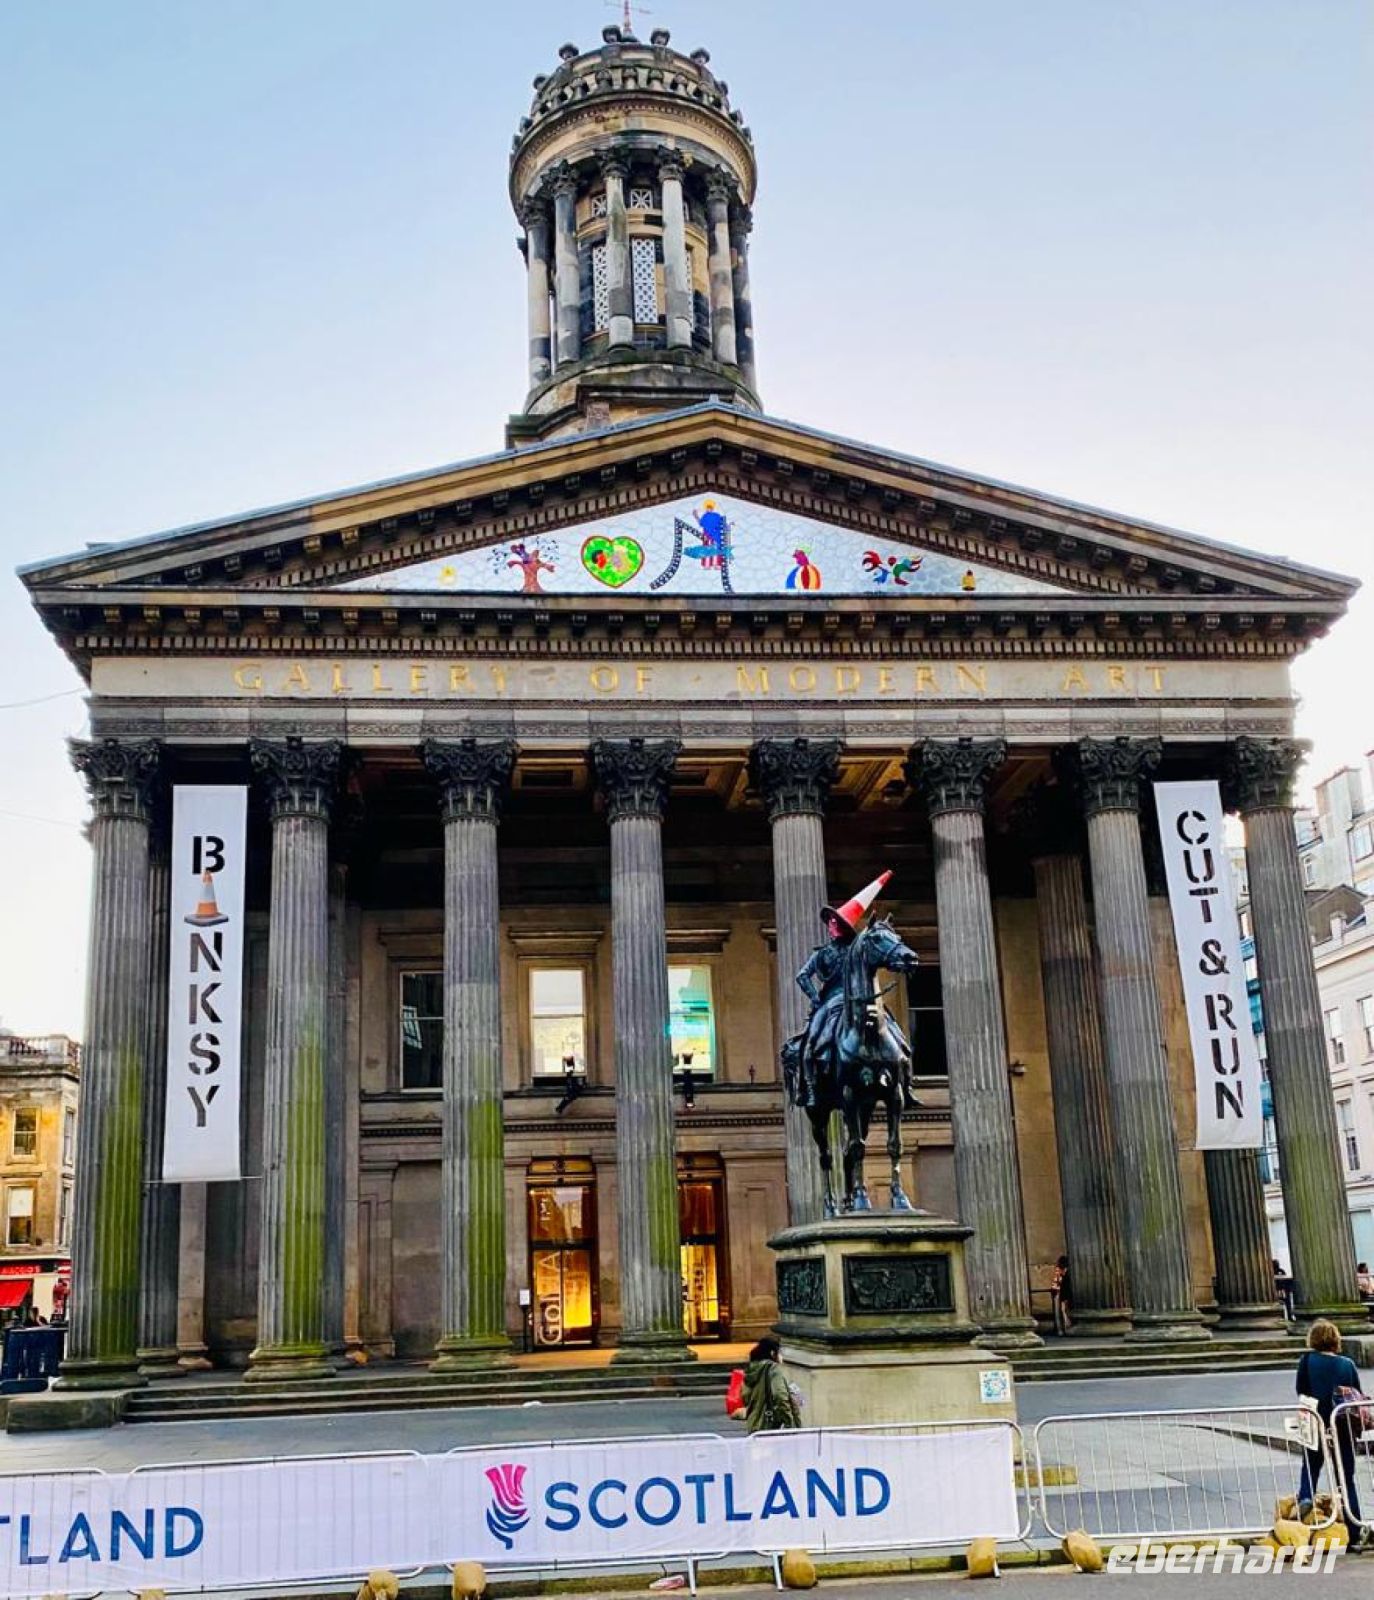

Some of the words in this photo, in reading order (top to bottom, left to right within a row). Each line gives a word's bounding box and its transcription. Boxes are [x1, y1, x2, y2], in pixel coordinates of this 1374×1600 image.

[232, 662, 513, 693] GALLERY
[588, 662, 653, 693] OF
[735, 664, 990, 694] MODERN
[1063, 664, 1167, 693] ART
[1176, 810, 1219, 923] CUT
[185, 835, 229, 1127] BNKSY
[1199, 938, 1230, 976] &
[1205, 993, 1244, 1120] RUN
[545, 1467, 891, 1532] SCOTLAND
[0, 1507, 204, 1565] LAND
